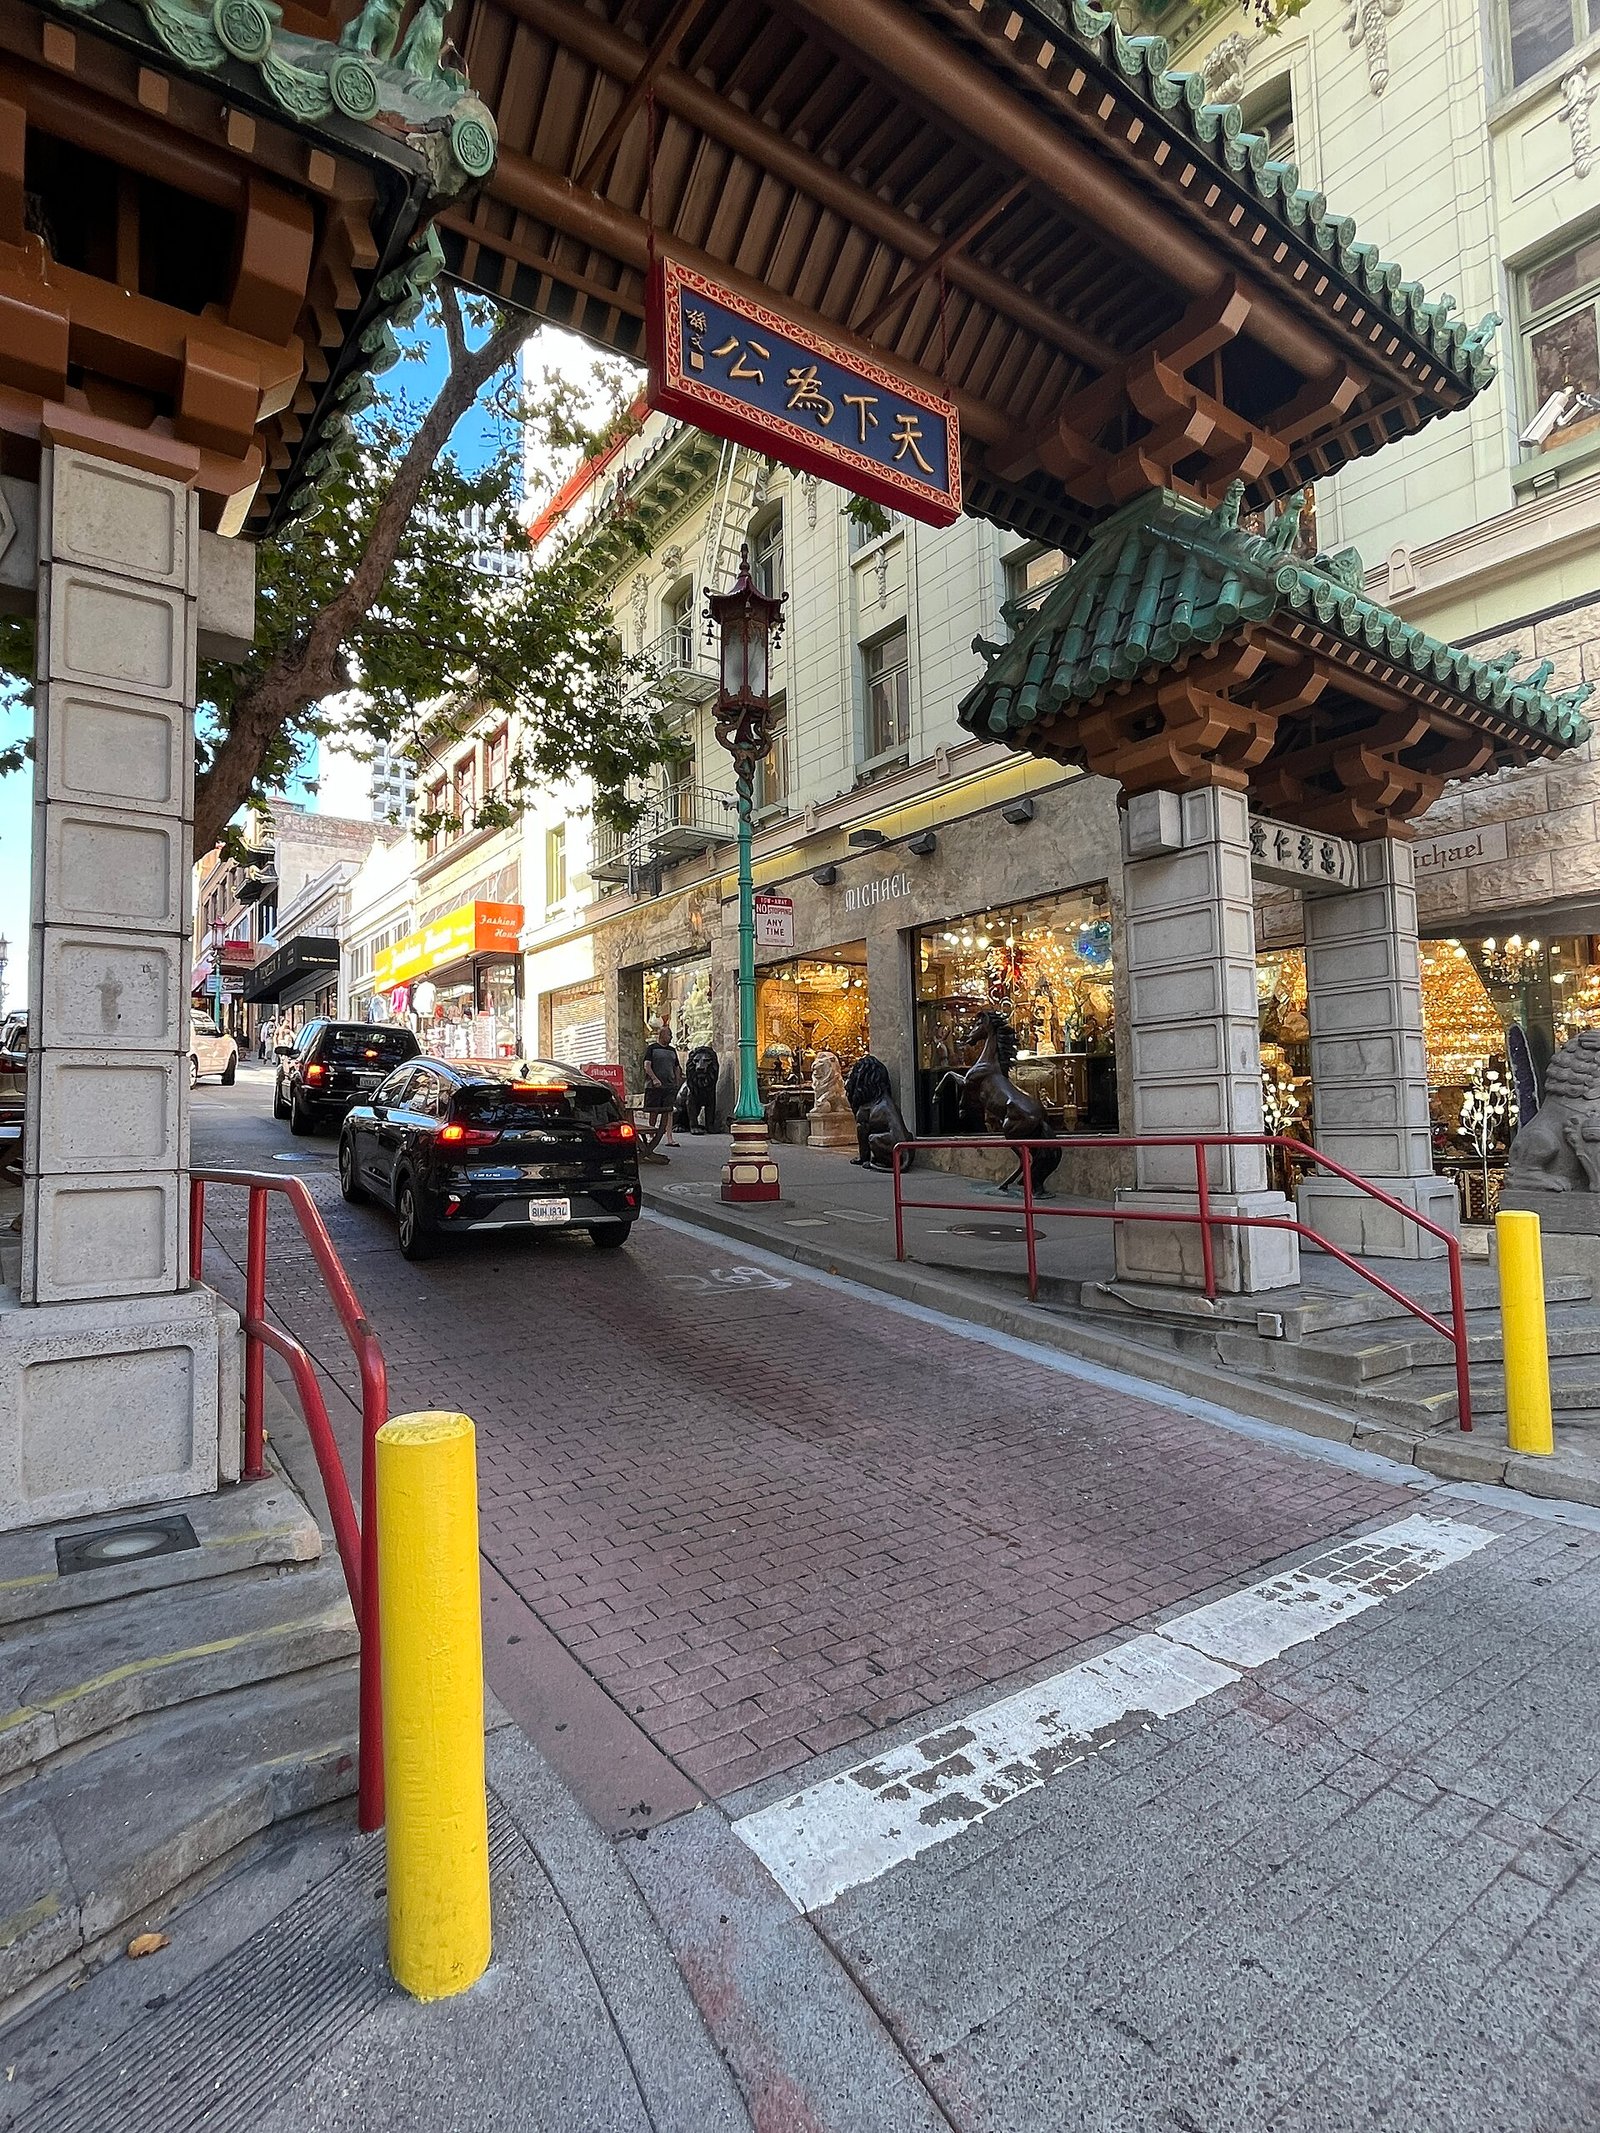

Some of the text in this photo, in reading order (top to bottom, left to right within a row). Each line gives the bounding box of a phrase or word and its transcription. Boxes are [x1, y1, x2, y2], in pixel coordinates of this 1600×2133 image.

[1412, 834, 1484, 869] ichael
[845, 873, 912, 913] MICHAEL
[756, 903, 768, 914] NO
[479, 914, 517, 926] Fashion
[766, 918, 783, 927] ANY
[765, 927, 785, 937] TIME
